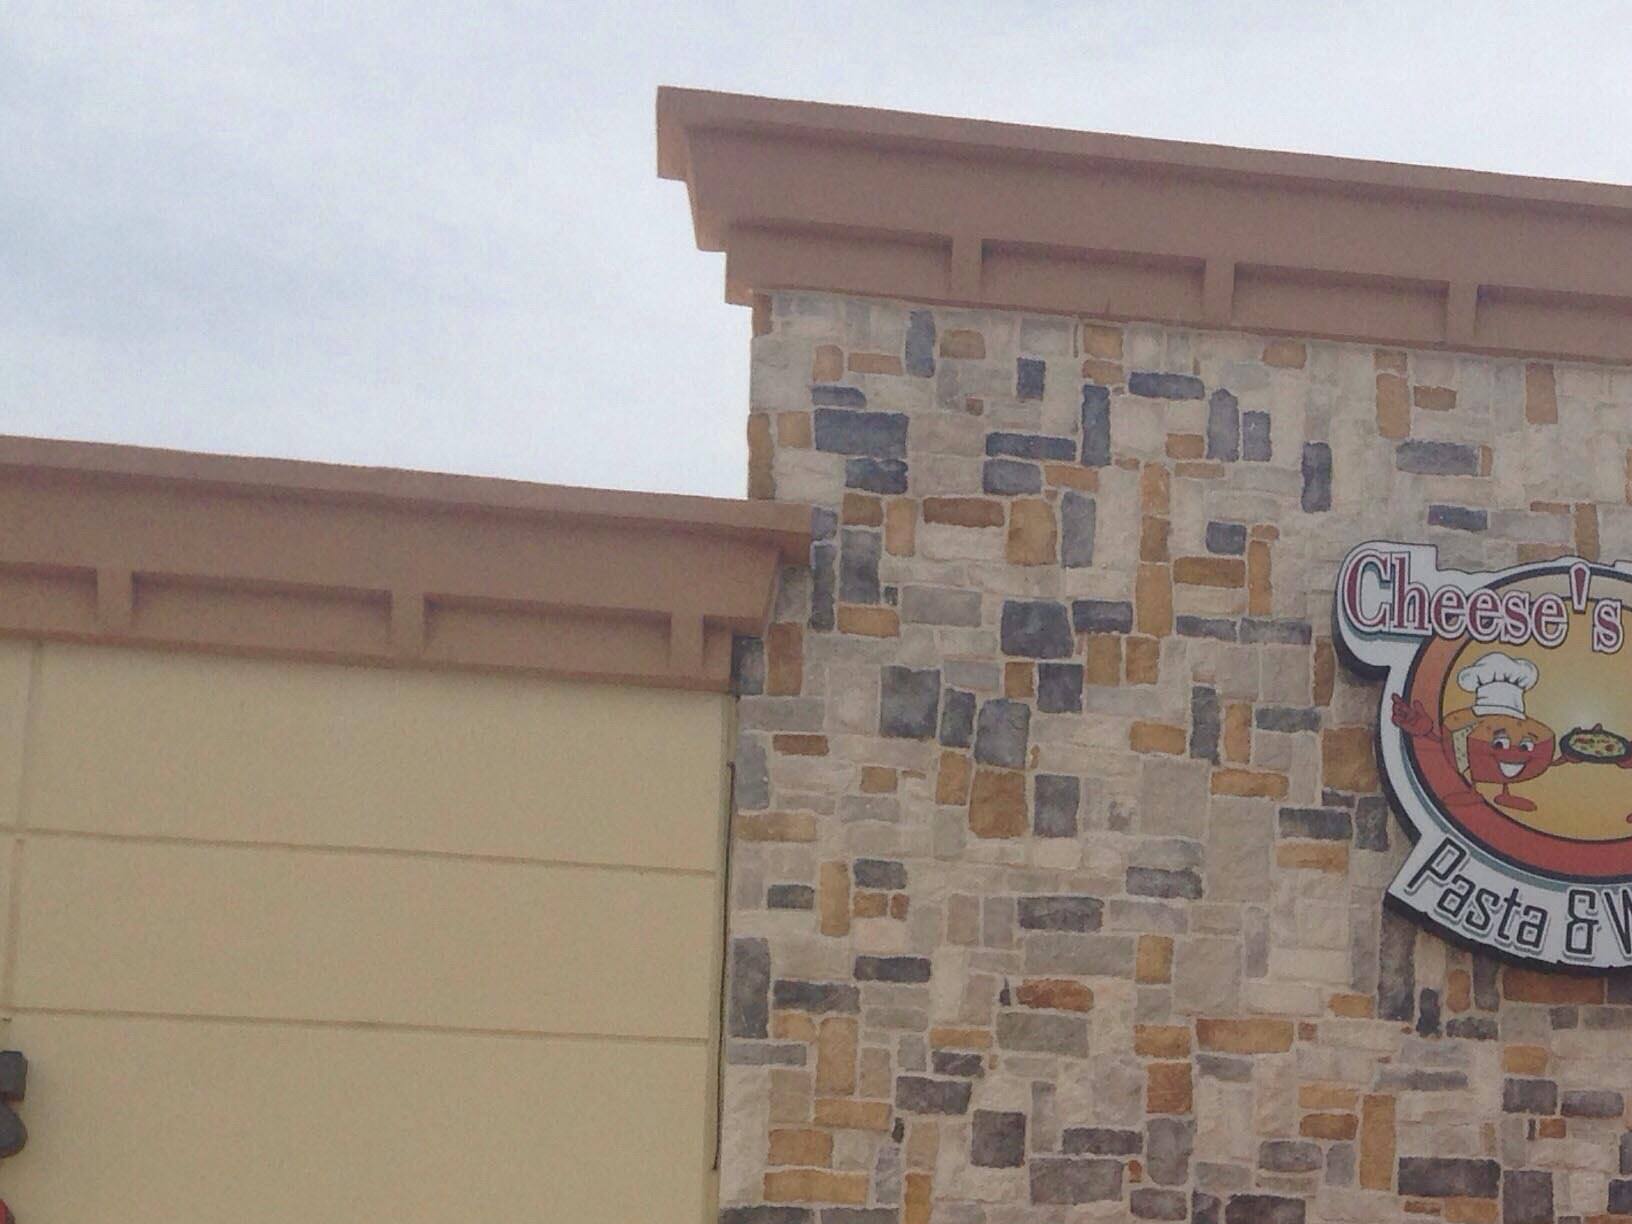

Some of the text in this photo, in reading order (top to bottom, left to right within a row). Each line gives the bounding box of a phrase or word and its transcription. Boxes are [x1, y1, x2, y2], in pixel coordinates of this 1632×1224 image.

[1341, 548, 1622, 655] Cheese's
[1405, 836, 1546, 953] Pasta
[1565, 889, 1600, 956] &
